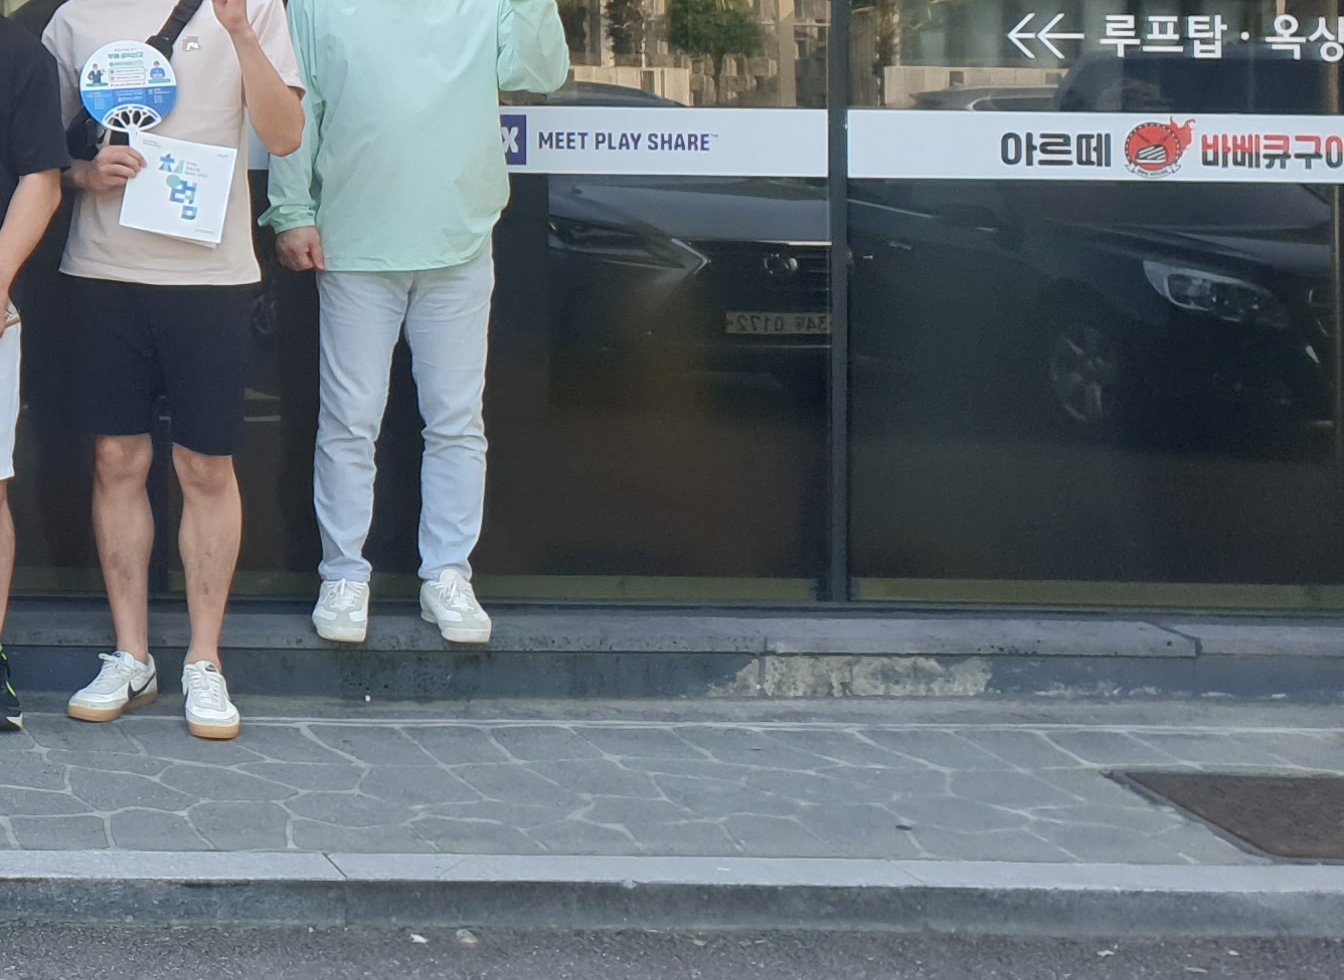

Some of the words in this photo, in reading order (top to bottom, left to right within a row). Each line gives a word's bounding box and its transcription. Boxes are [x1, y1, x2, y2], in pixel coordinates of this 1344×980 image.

[1099, 14, 1228, 60] 루프탑
[1265, 14, 1344, 62] 옥상
[538, 131, 588, 150] MEET
[594, 132, 642, 151] PLAY
[1000, 132, 1111, 168] 아르떼
